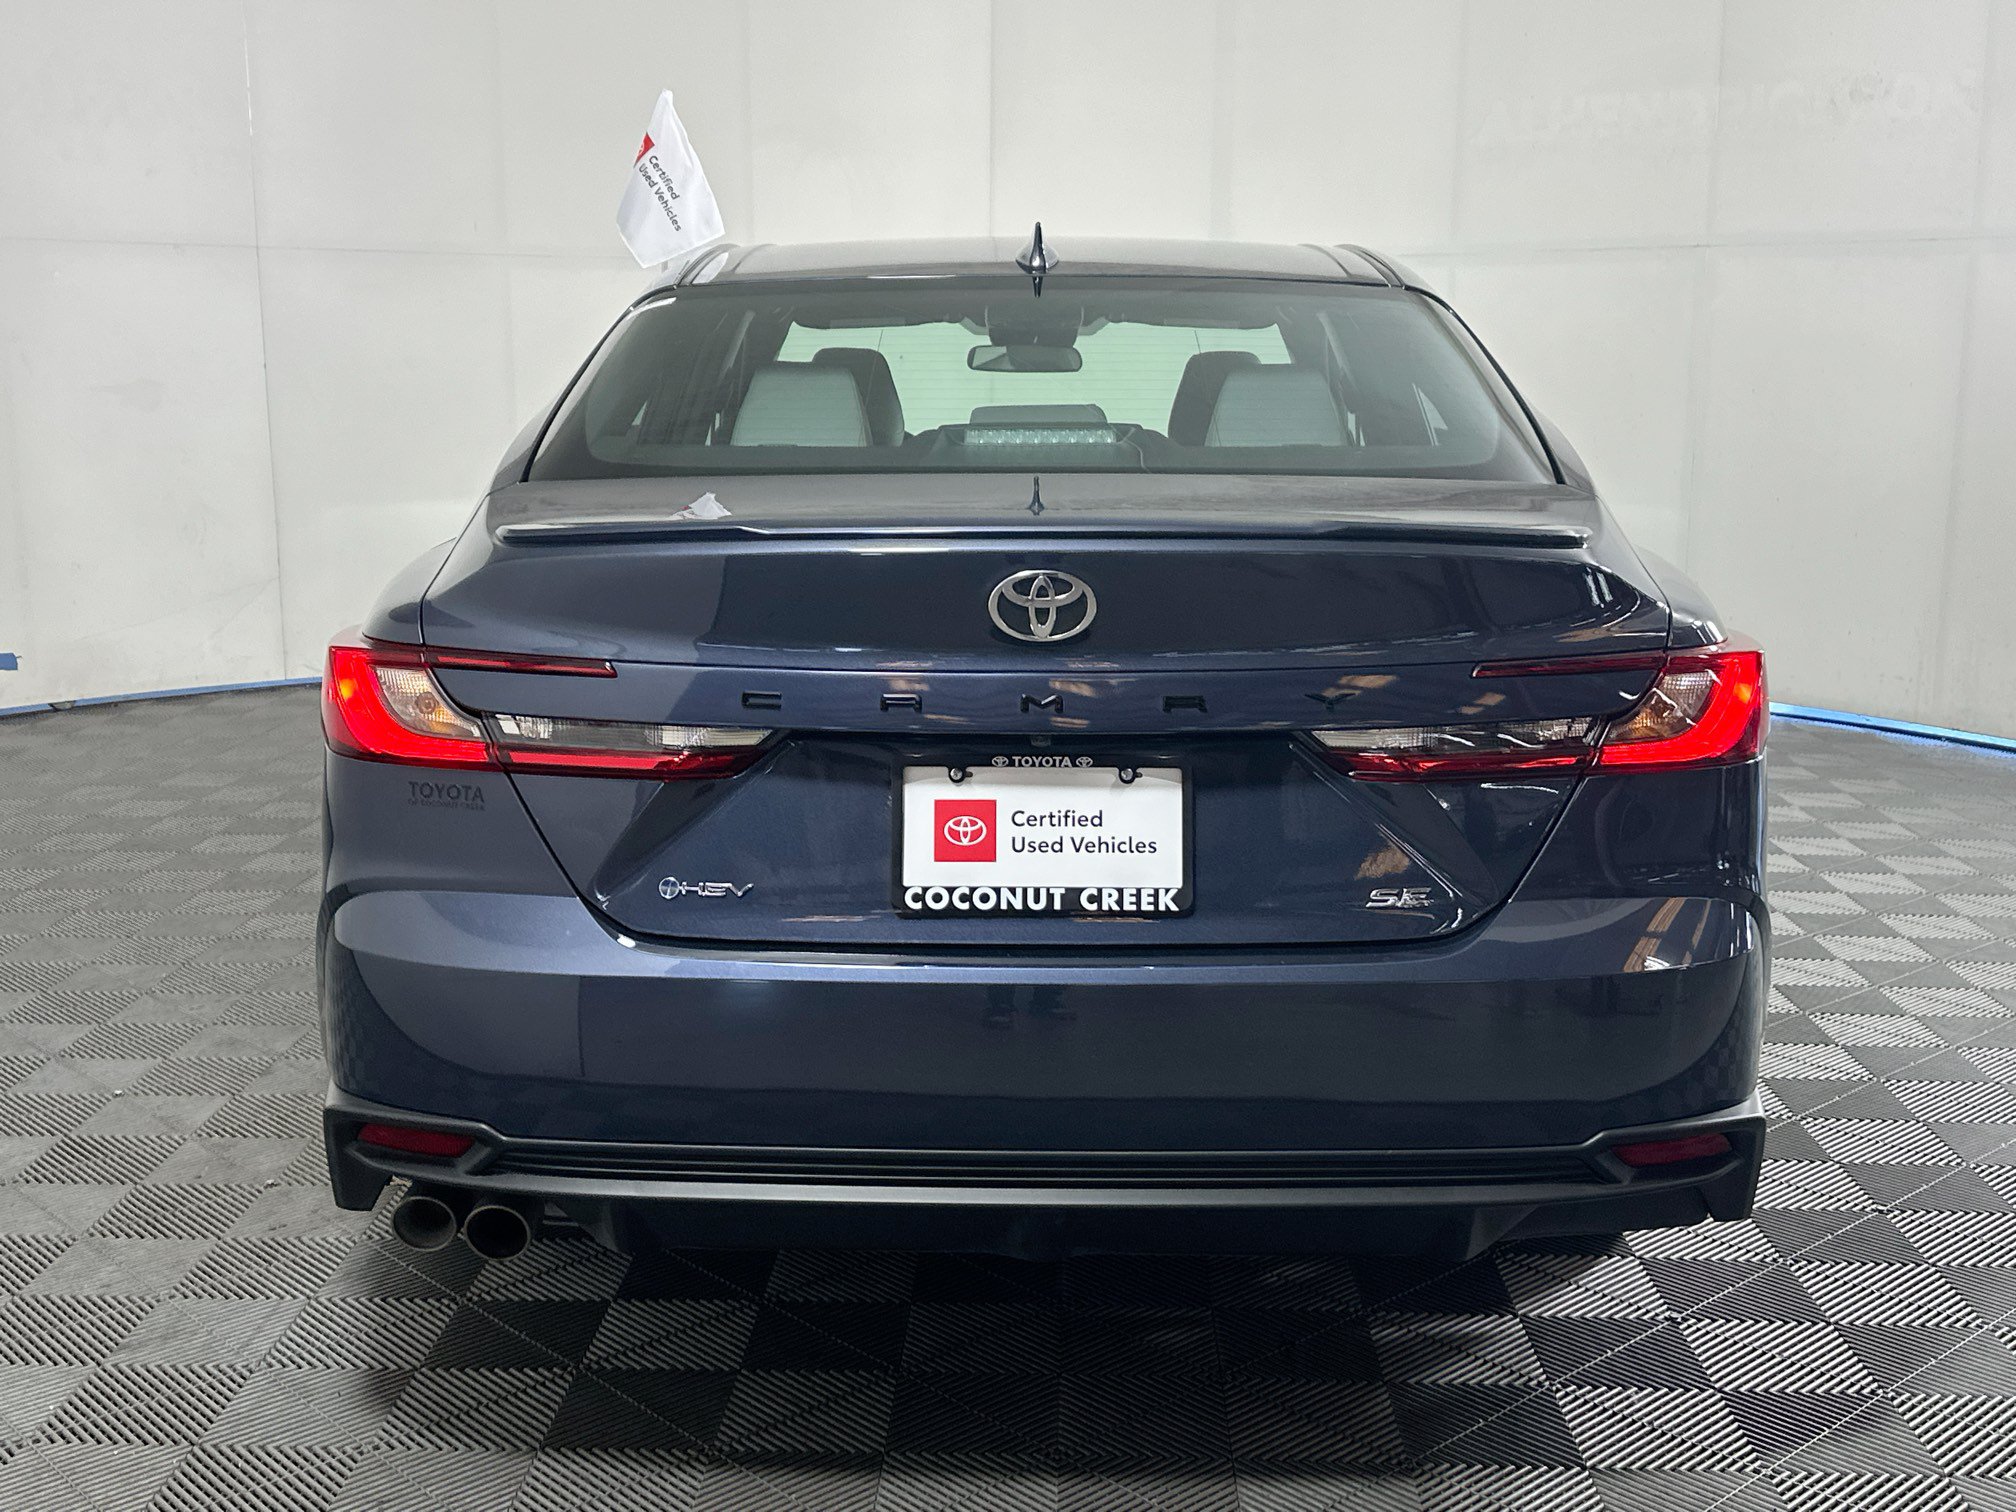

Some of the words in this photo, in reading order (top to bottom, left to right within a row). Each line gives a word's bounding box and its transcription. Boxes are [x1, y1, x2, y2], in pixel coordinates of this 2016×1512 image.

[649, 155, 680, 200] Certified
[638, 163, 657, 189] Used
[654, 187, 682, 232] Vehicles
[741, 690, 1357, 714] CAMRY
[1012, 756, 1072, 768] TOYOTA
[408, 781, 485, 803] TOYOTA
[1011, 810, 1103, 828] Certified
[1011, 836, 1063, 854] Used
[1070, 836, 1158, 854] Vehicles
[681, 881, 754, 897] HEV
[904, 886, 1066, 911] COCONUT
[1079, 887, 1180, 912] CREEK
[1365, 887, 1432, 908] SE
